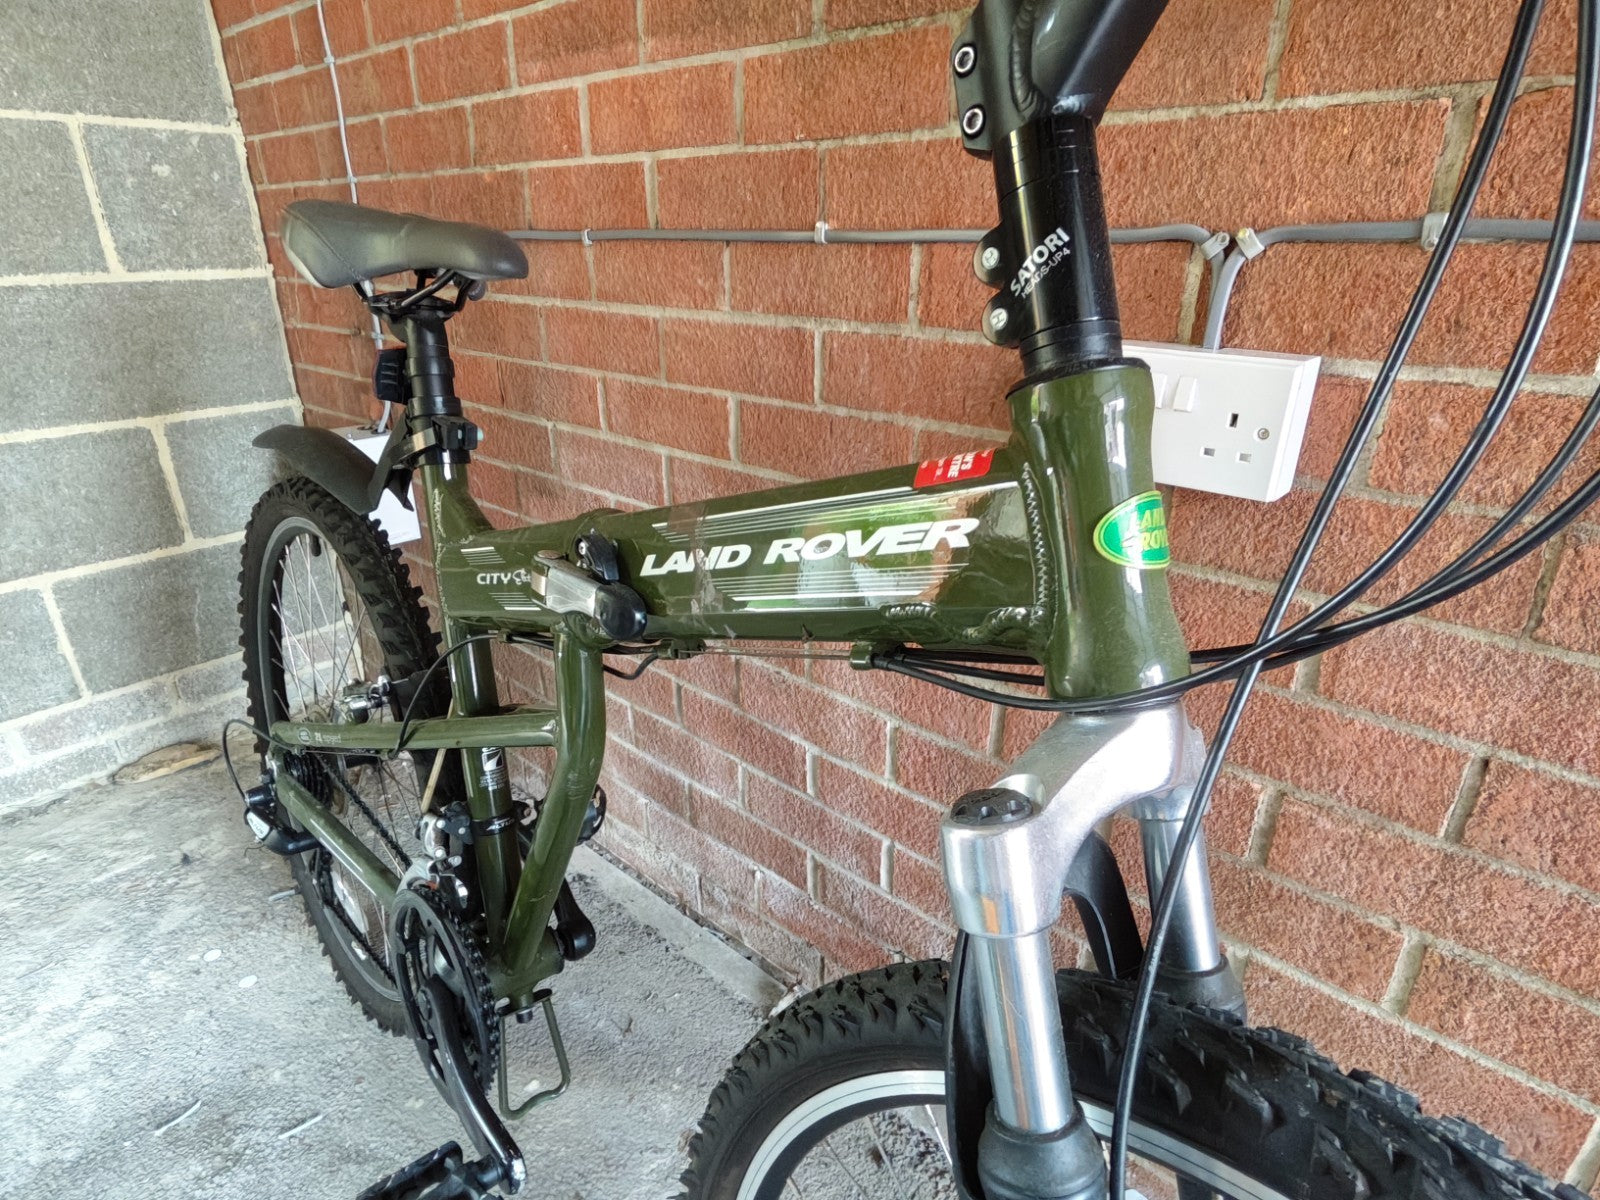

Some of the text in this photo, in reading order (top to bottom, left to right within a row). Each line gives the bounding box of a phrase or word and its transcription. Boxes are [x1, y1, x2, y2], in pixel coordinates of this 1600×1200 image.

[1010, 227, 1070, 297] SATORI
[639, 517, 980, 577] LAND ROVER
[476, 572, 512, 585] CITY
